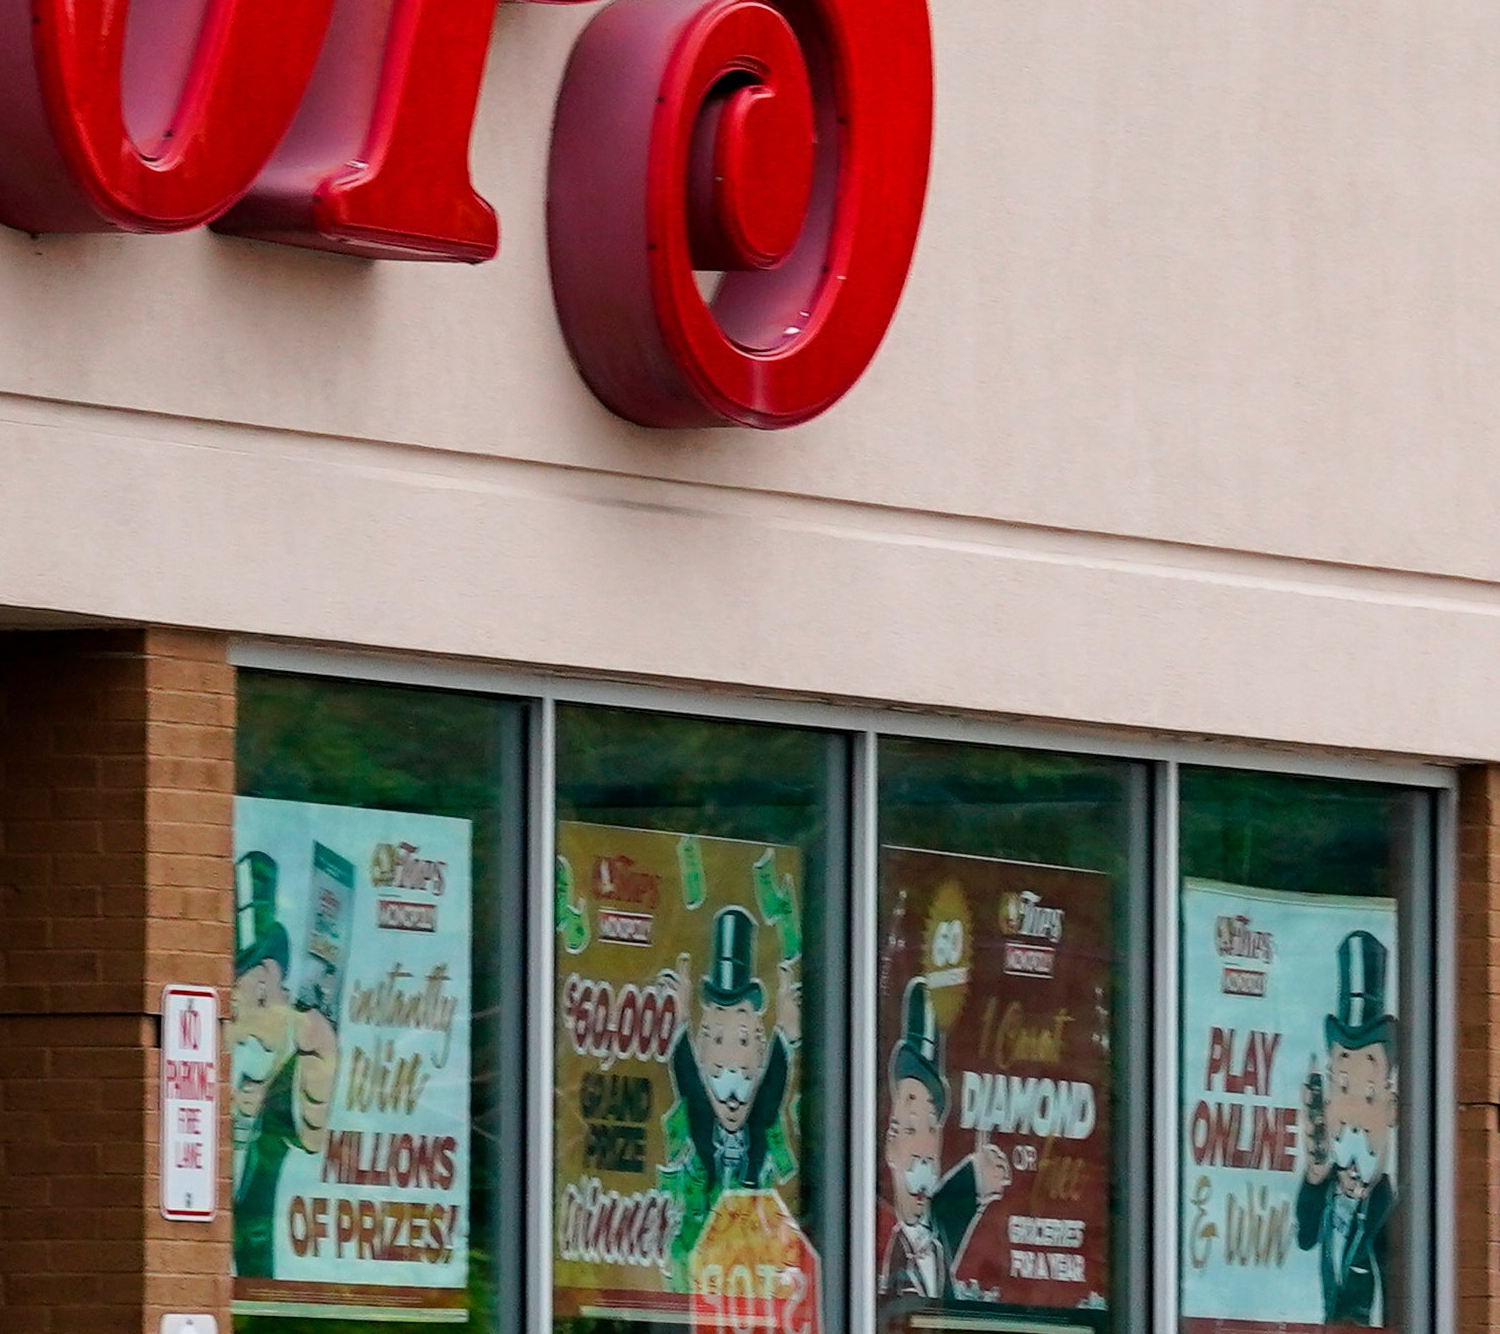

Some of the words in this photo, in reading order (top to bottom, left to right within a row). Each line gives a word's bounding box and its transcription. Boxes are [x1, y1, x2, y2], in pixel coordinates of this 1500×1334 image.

[349, 962, 458, 1069] instantly
[564, 975, 677, 1067] $60,000
[165, 1059, 216, 1101] PARKING
[1204, 1026, 1283, 1097] PLAY
[959, 1070, 1097, 1140] DIAMOND
[1191, 1099, 1300, 1172] ONLINE
[320, 1129, 459, 1191] MILLIONS
[1011, 1145, 1038, 1171] OR
[289, 1195, 329, 1259] OF
[335, 1198, 461, 1264] PRIZES!
